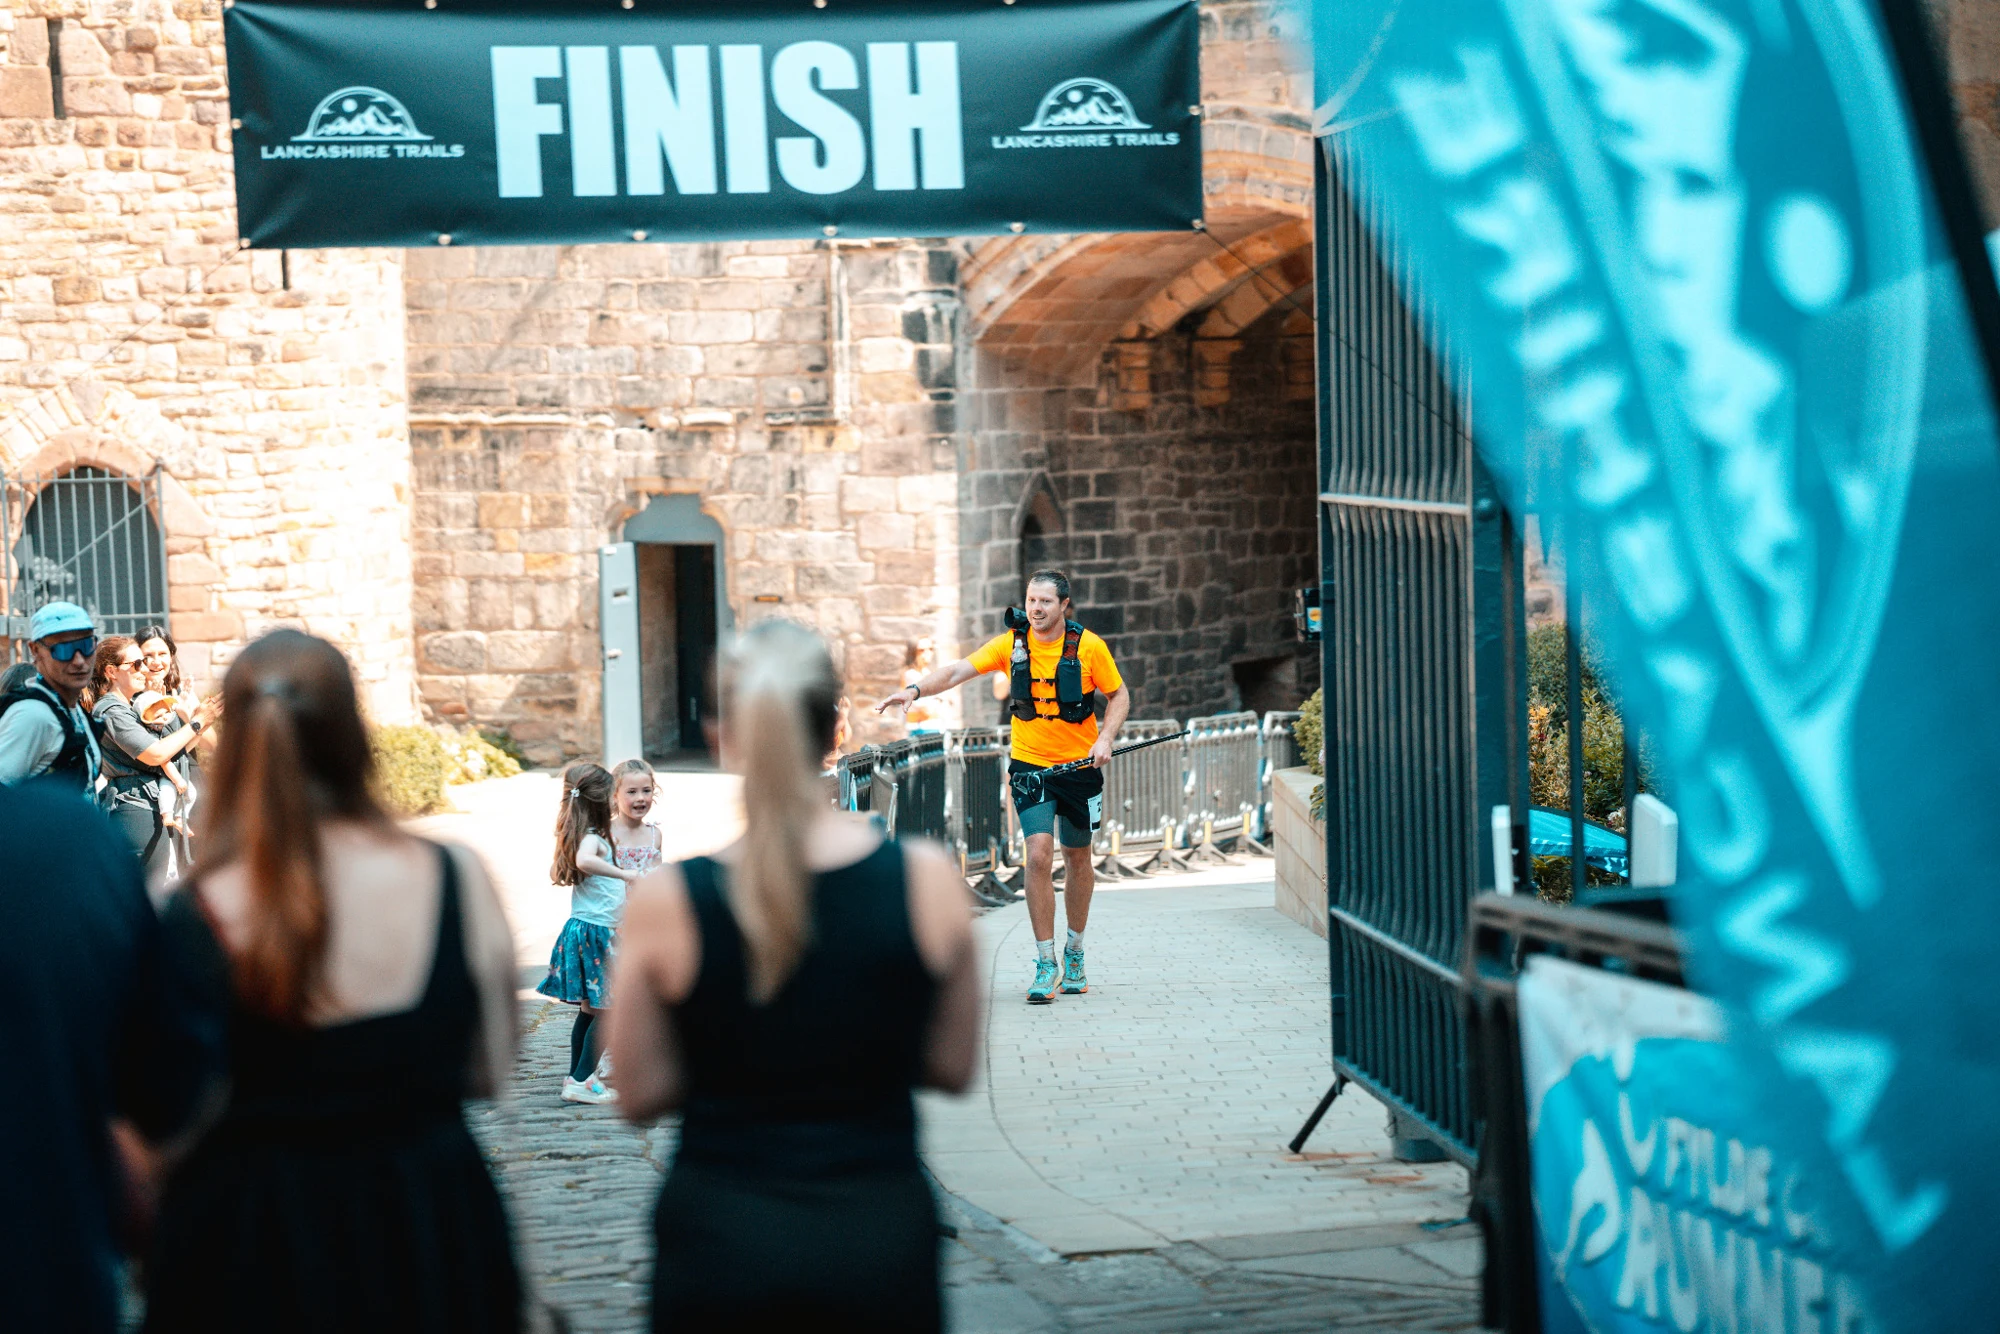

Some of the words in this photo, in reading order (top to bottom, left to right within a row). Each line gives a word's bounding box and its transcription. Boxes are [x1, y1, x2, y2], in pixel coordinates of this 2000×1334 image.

[490, 40, 965, 198] FINISH
[991, 133, 1112, 149] LANCASHIRE
[1113, 131, 1180, 147] TRAILS
[260, 144, 390, 159] LANCASHIRE
[393, 143, 465, 158] TRAILS
